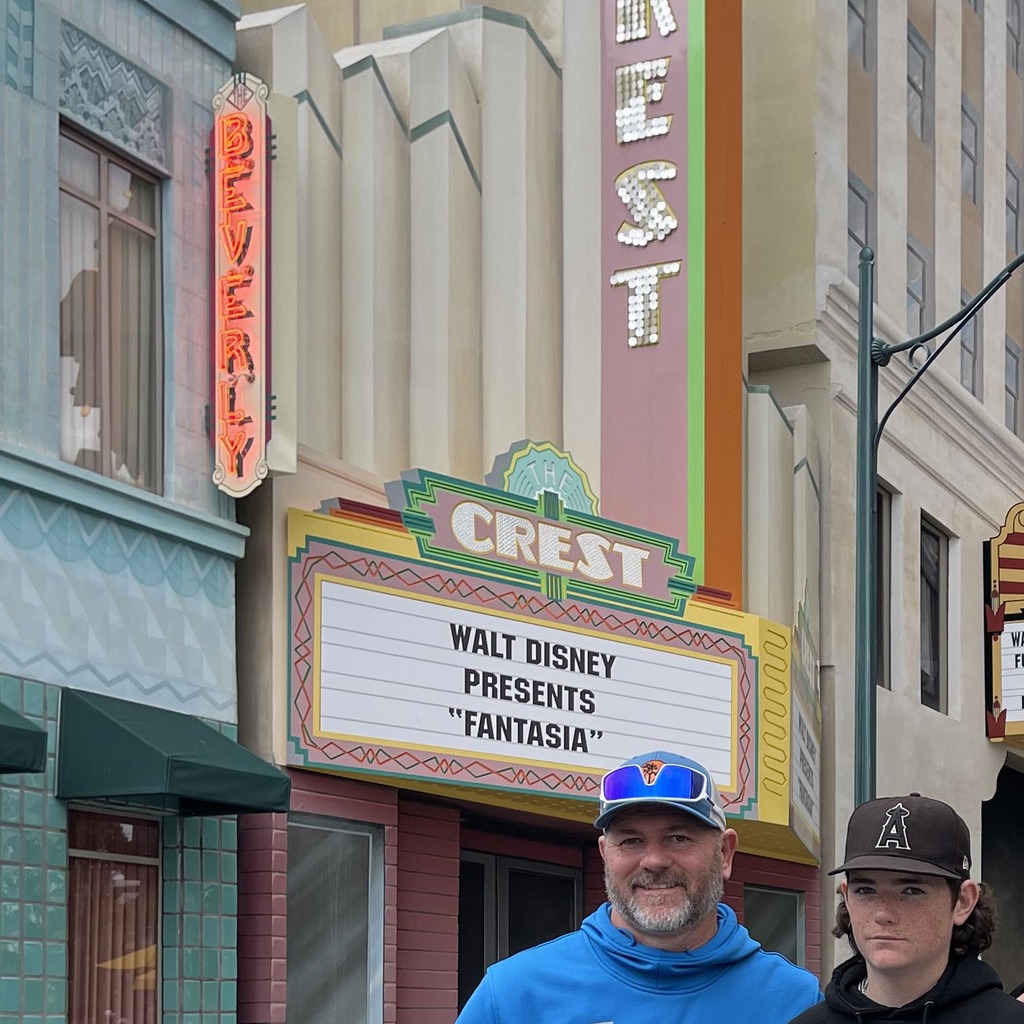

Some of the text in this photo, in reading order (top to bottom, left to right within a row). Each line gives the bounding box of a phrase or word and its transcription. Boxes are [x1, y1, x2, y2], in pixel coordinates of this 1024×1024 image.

[218, 112, 253, 477] BEVERLY
[527, 459, 574, 494] THE
[451, 500, 650, 589] CREST
[449, 623, 617, 678] WALT DISNEY
[464, 668, 596, 714] PRESENTS
[449, 707, 603, 753] "FANTASIA"
[875, 803, 911, 850] A
